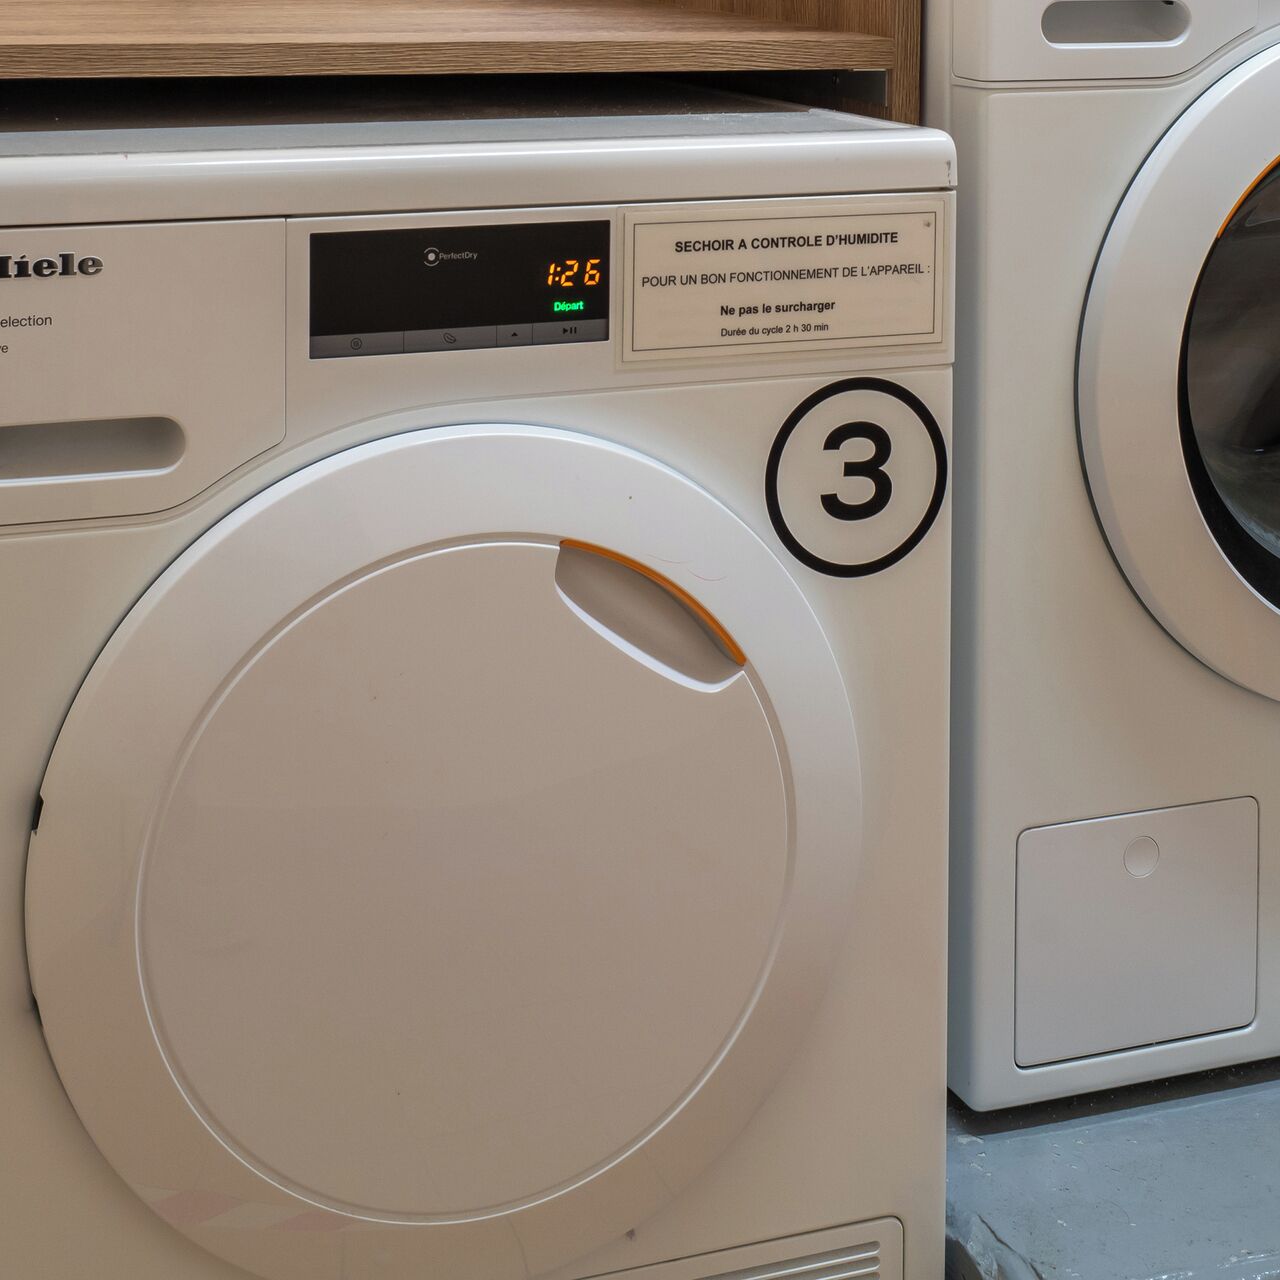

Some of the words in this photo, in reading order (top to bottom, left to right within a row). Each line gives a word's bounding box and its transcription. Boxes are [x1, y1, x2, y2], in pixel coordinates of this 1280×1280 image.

[675, 239, 734, 252] SECHOIR
[738, 238, 747, 249] A
[751, 235, 822, 249] CONTROLE
[827, 231, 898, 246] D'HUMIDITE
[439, 251, 478, 260] PerfectDry
[547, 258, 601, 287] 1:26
[642, 275, 676, 287] POUR
[680, 274, 697, 285] UN
[701, 272, 726, 284] BON
[730, 267, 839, 282] FONCTIONNEMENT
[843, 266, 857, 277] DE
[861, 263, 925, 276] L'APPAREIL
[553, 300, 584, 312] Départ
[721, 304, 735, 316] Ne
[739, 305, 758, 317] pas
[762, 303, 772, 313] le
[775, 301, 835, 313] surcharger
[721, 327, 746, 337] Durée
[749, 326, 759, 335] du
[762, 325, 783, 336] cycle
[786, 324, 791, 333] 2
[793, 323, 798, 332] h
[801, 323, 811, 332] 30
[814, 322, 828, 331] min
[819, 420, 893, 522] 3
